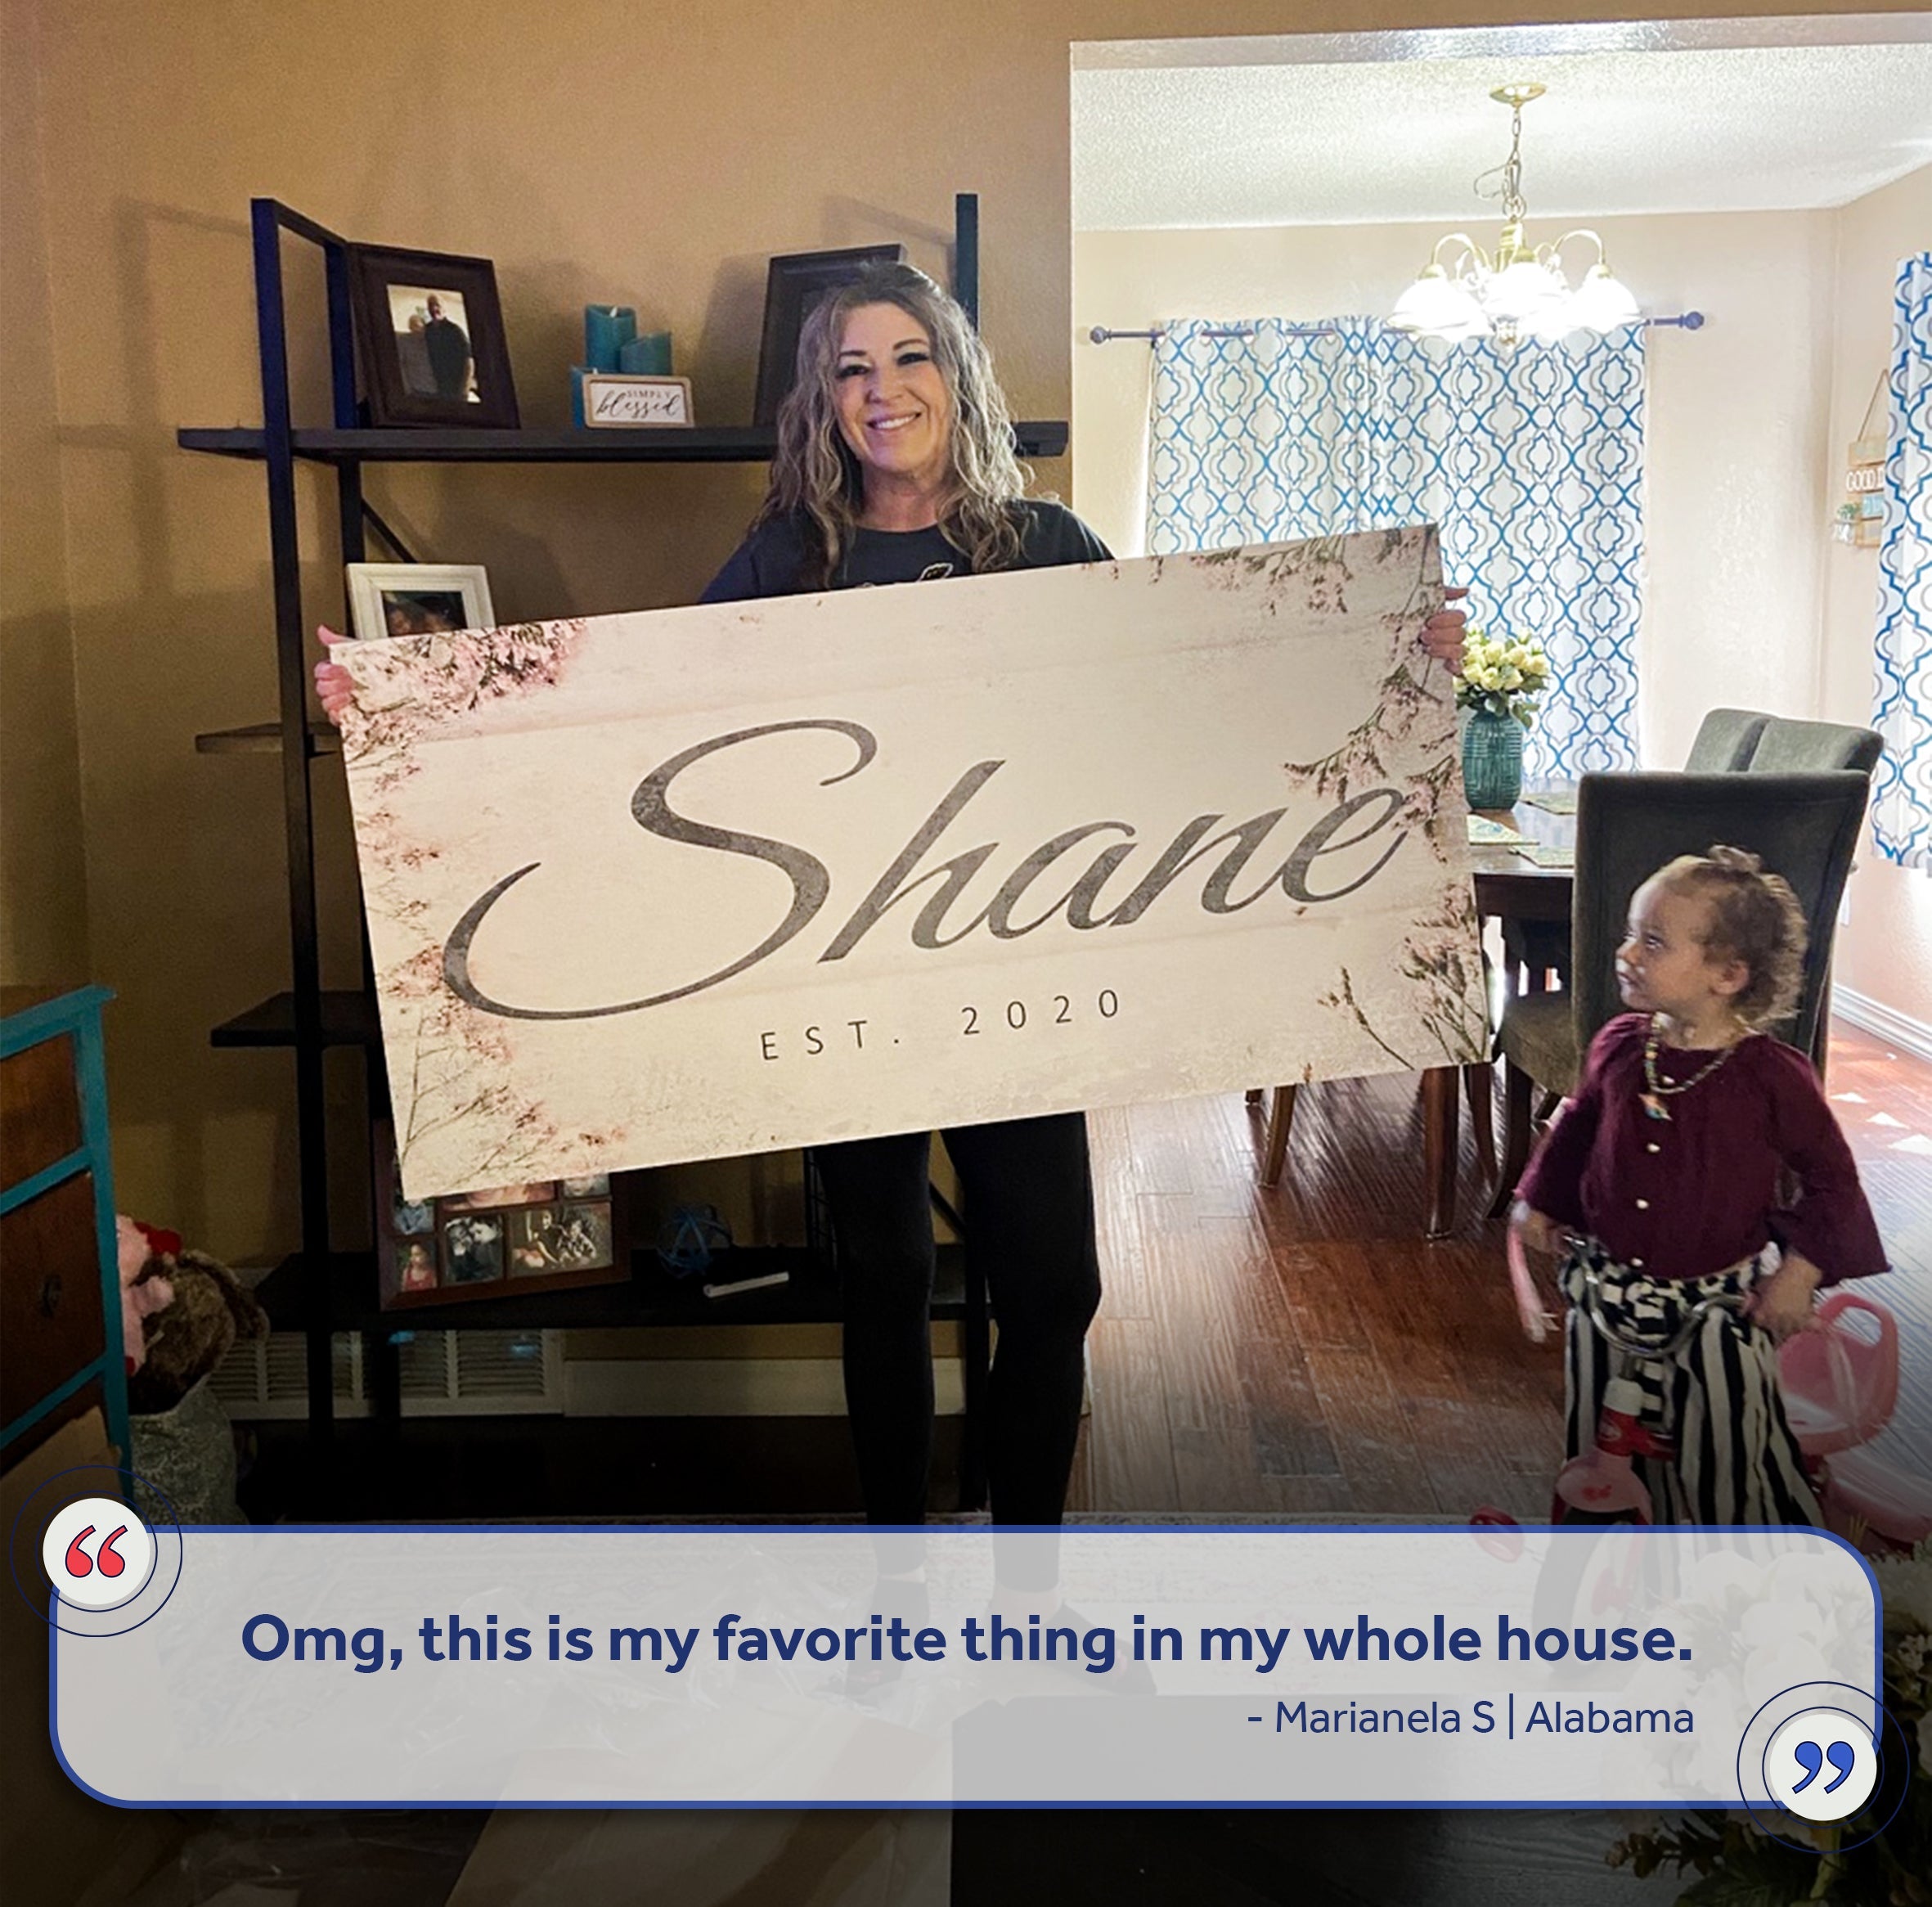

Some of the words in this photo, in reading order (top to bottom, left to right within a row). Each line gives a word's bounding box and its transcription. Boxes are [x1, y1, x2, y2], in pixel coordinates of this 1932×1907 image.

[595, 389, 681, 419] blessed
[626, 389, 672, 399] SIMPLY
[442, 718, 1409, 1020] Shane
[761, 1020, 903, 1060] EST.
[961, 990, 1121, 1036] 2020
